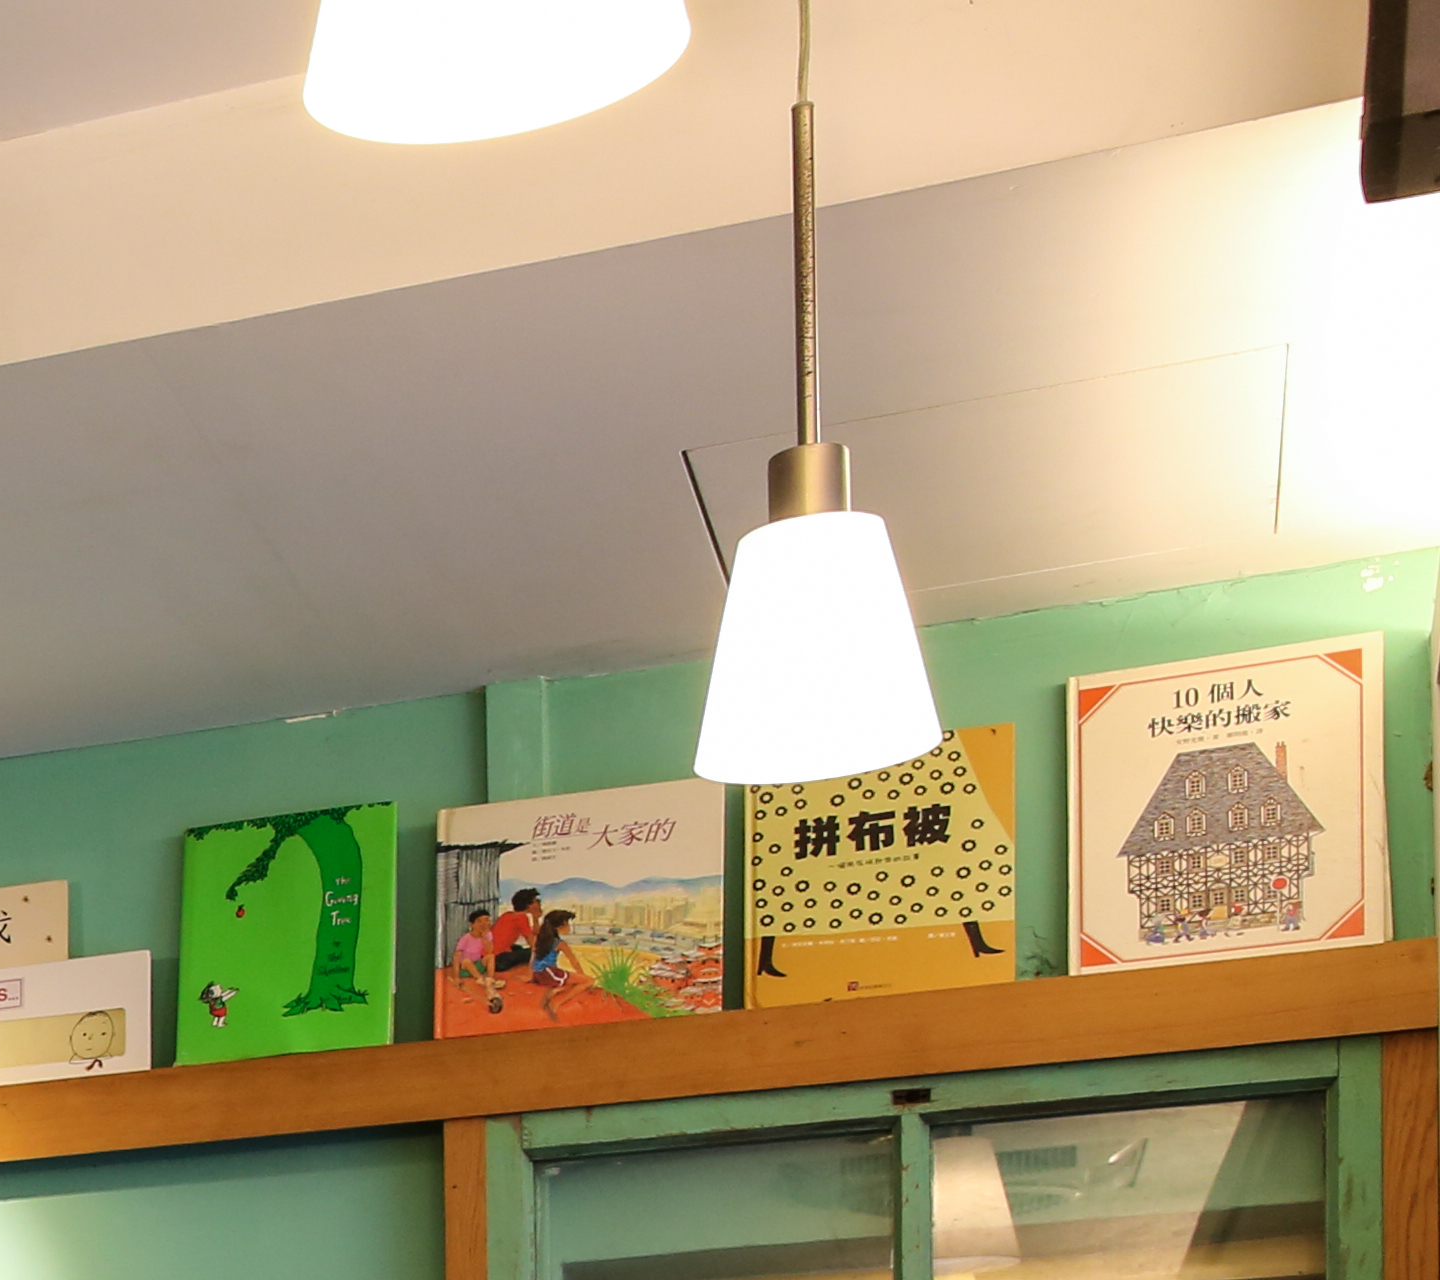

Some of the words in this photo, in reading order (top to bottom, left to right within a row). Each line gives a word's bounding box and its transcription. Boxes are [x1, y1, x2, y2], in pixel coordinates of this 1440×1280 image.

[1147, 699, 1291, 738] 快樂的搬家
[532, 813, 676, 849] 街道是大家的
[794, 804, 951, 860] 拼布被
